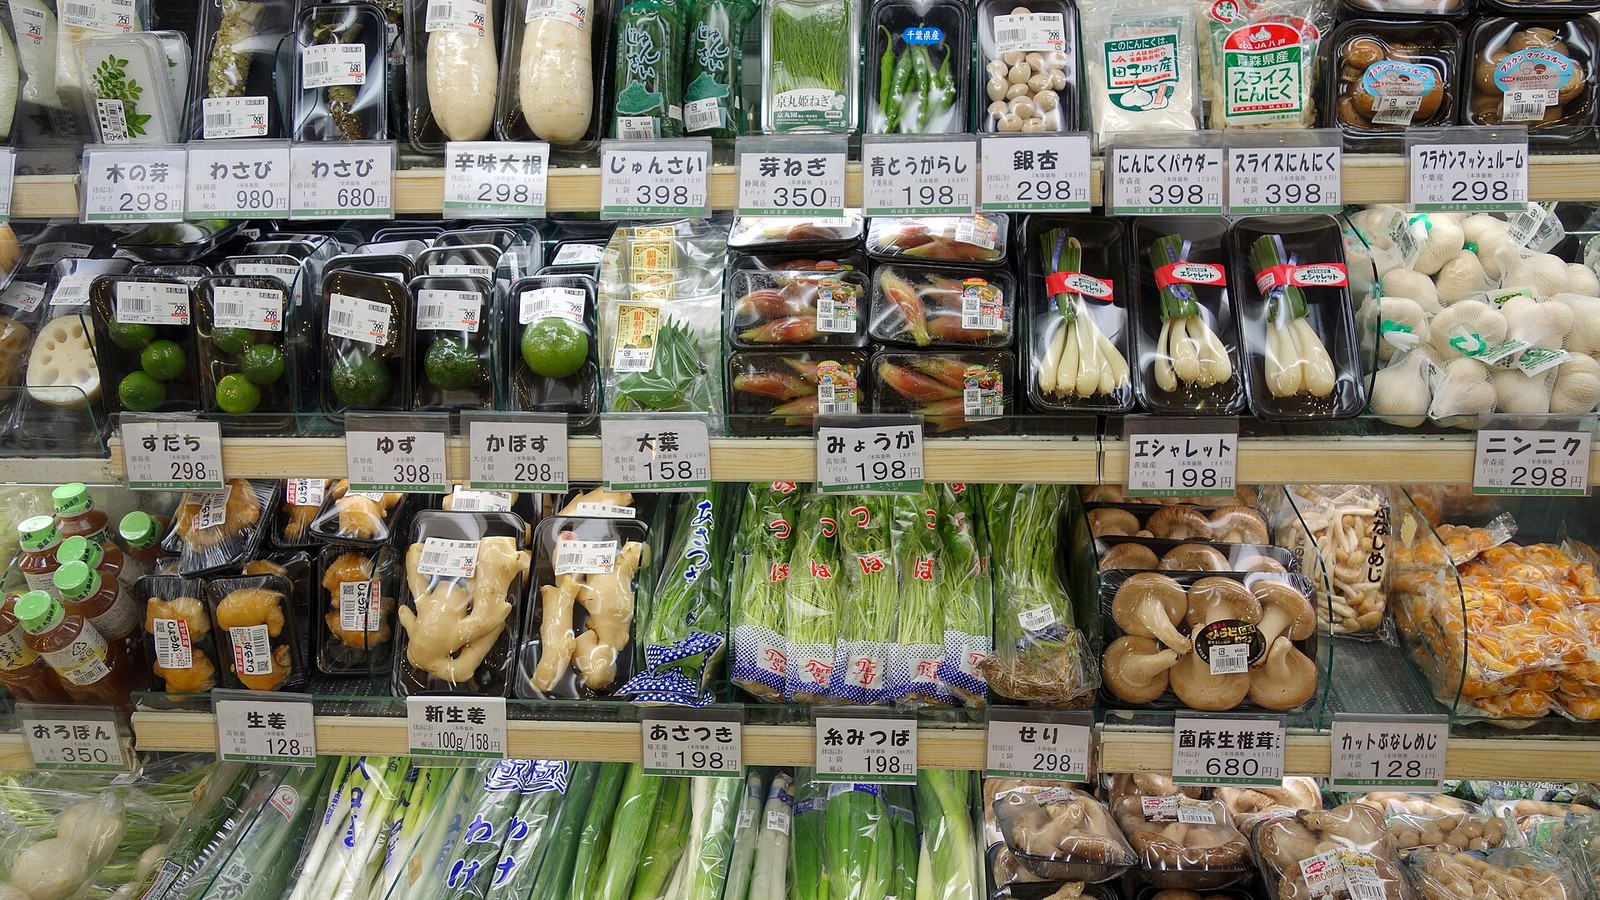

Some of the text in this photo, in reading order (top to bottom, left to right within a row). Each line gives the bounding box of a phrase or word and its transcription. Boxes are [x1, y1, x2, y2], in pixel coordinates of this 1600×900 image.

[907, 30, 940, 41] 千葉県産
[1255, 40, 1286, 50] JA八戸
[625, 22, 660, 79] じゅんさい
[697, 21, 730, 71] じゅんさい
[1113, 56, 1172, 78] 田子町産
[1237, 51, 1289, 66] 青森県産
[1501, 52, 1568, 72] ブラウン マッシュルーム
[1233, 67, 1294, 86] スライス
[1368, 64, 1430, 79] ブラウン マッシュルーム
[776, 94, 830, 108] 京丸姫ねぎ
[1234, 85, 1292, 102] にんにく
[1234, 104, 1262, 112] TAKKO
[311, 159, 374, 178] わさび
[455, 153, 541, 174] 辛味大根
[611, 156, 702, 175] じゅんさい
[760, 157, 826, 177] 芽ねぎ
[871, 155, 967, 176] 青とうがらし
[1013, 150, 1058, 171] 銀杏
[1119, 154, 1218, 173] にんにくパウダー
[1236, 152, 1335, 172] スライスにんにく
[1420, 150, 1523, 170] ブラウンマッシュルーム
[107, 163, 169, 183] 木の芽
[210, 161, 272, 180] わさび
[237, 190, 286, 209] 980円
[338, 188, 387, 207] 680円
[477, 183, 542, 203] 298円
[637, 185, 702, 205] 398円
[773, 188, 840, 207] 350円
[902, 186, 968, 205] 198円
[1017, 181, 1086, 200] 298円
[1149, 185, 1218, 205] 398円
[1266, 184, 1336, 204] 398円
[1452, 181, 1523, 201] 298円
[120, 193, 181, 211] 298円
[1301, 273, 1338, 281] エシャレット
[1072, 281, 1104, 294] エシャレット
[142, 434, 200, 452] すだち
[376, 437, 415, 454] ゆず
[487, 434, 548, 453] かぼす
[637, 432, 679, 452] 大葉
[827, 430, 914, 453] みょうが
[1135, 439, 1230, 458] エシャレット
[1486, 436, 1580, 456] ニンニク
[171, 463, 218, 480] 298円
[394, 465, 442, 483] 398円
[514, 464, 564, 482] 298円
[644, 461, 706, 480] 158円
[856, 461, 920, 481] 198円
[1165, 469, 1231, 487] 198円
[1511, 467, 1582, 487] 298円
[684, 500, 715, 580] あさつき
[1368, 508, 1386, 583] ぶなしめじ
[248, 712, 286, 729] 生姜
[425, 705, 485, 724] 新生姜
[33, 724, 111, 740] おろぽん
[650, 724, 733, 743] あさつき
[824, 728, 909, 746] 糸みつば
[1019, 726, 1057, 744] せり
[1179, 730, 1274, 750] 菌床生椎茸
[1342, 733, 1436, 750] カットぶなしめじ
[61, 747, 121, 763] 350円
[266, 739, 312, 756] 128円
[676, 752, 736, 769] 198円
[864, 756, 913, 774] 198円
[1033, 754, 1083, 773] 298円
[1206, 758, 1272, 776] 680円
[1370, 761, 1436, 778] 128円
